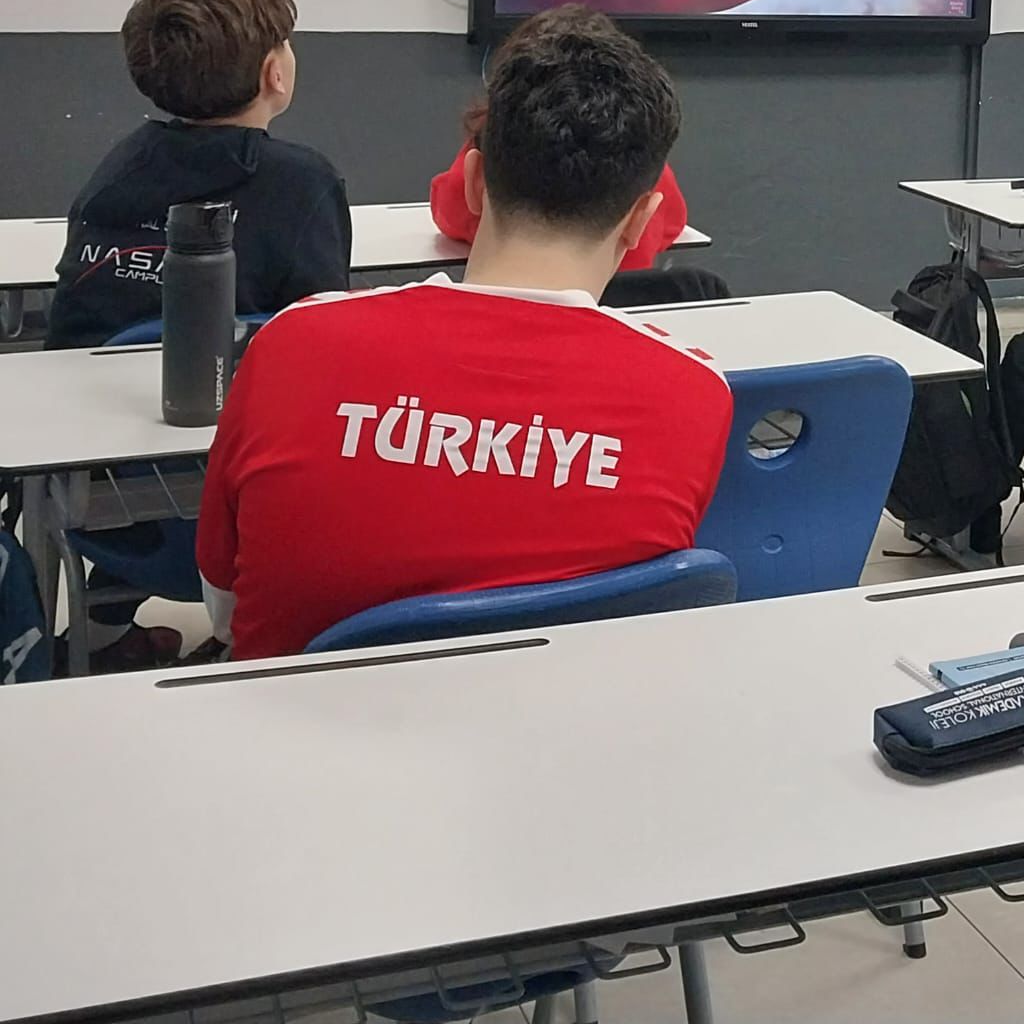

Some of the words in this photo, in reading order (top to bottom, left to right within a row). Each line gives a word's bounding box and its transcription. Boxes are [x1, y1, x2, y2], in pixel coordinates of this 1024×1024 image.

[215, 357, 224, 411] UZSPACE
[336, 395, 622, 489] TÜRKİYE
[930, 702, 968, 719] SCHOOL
